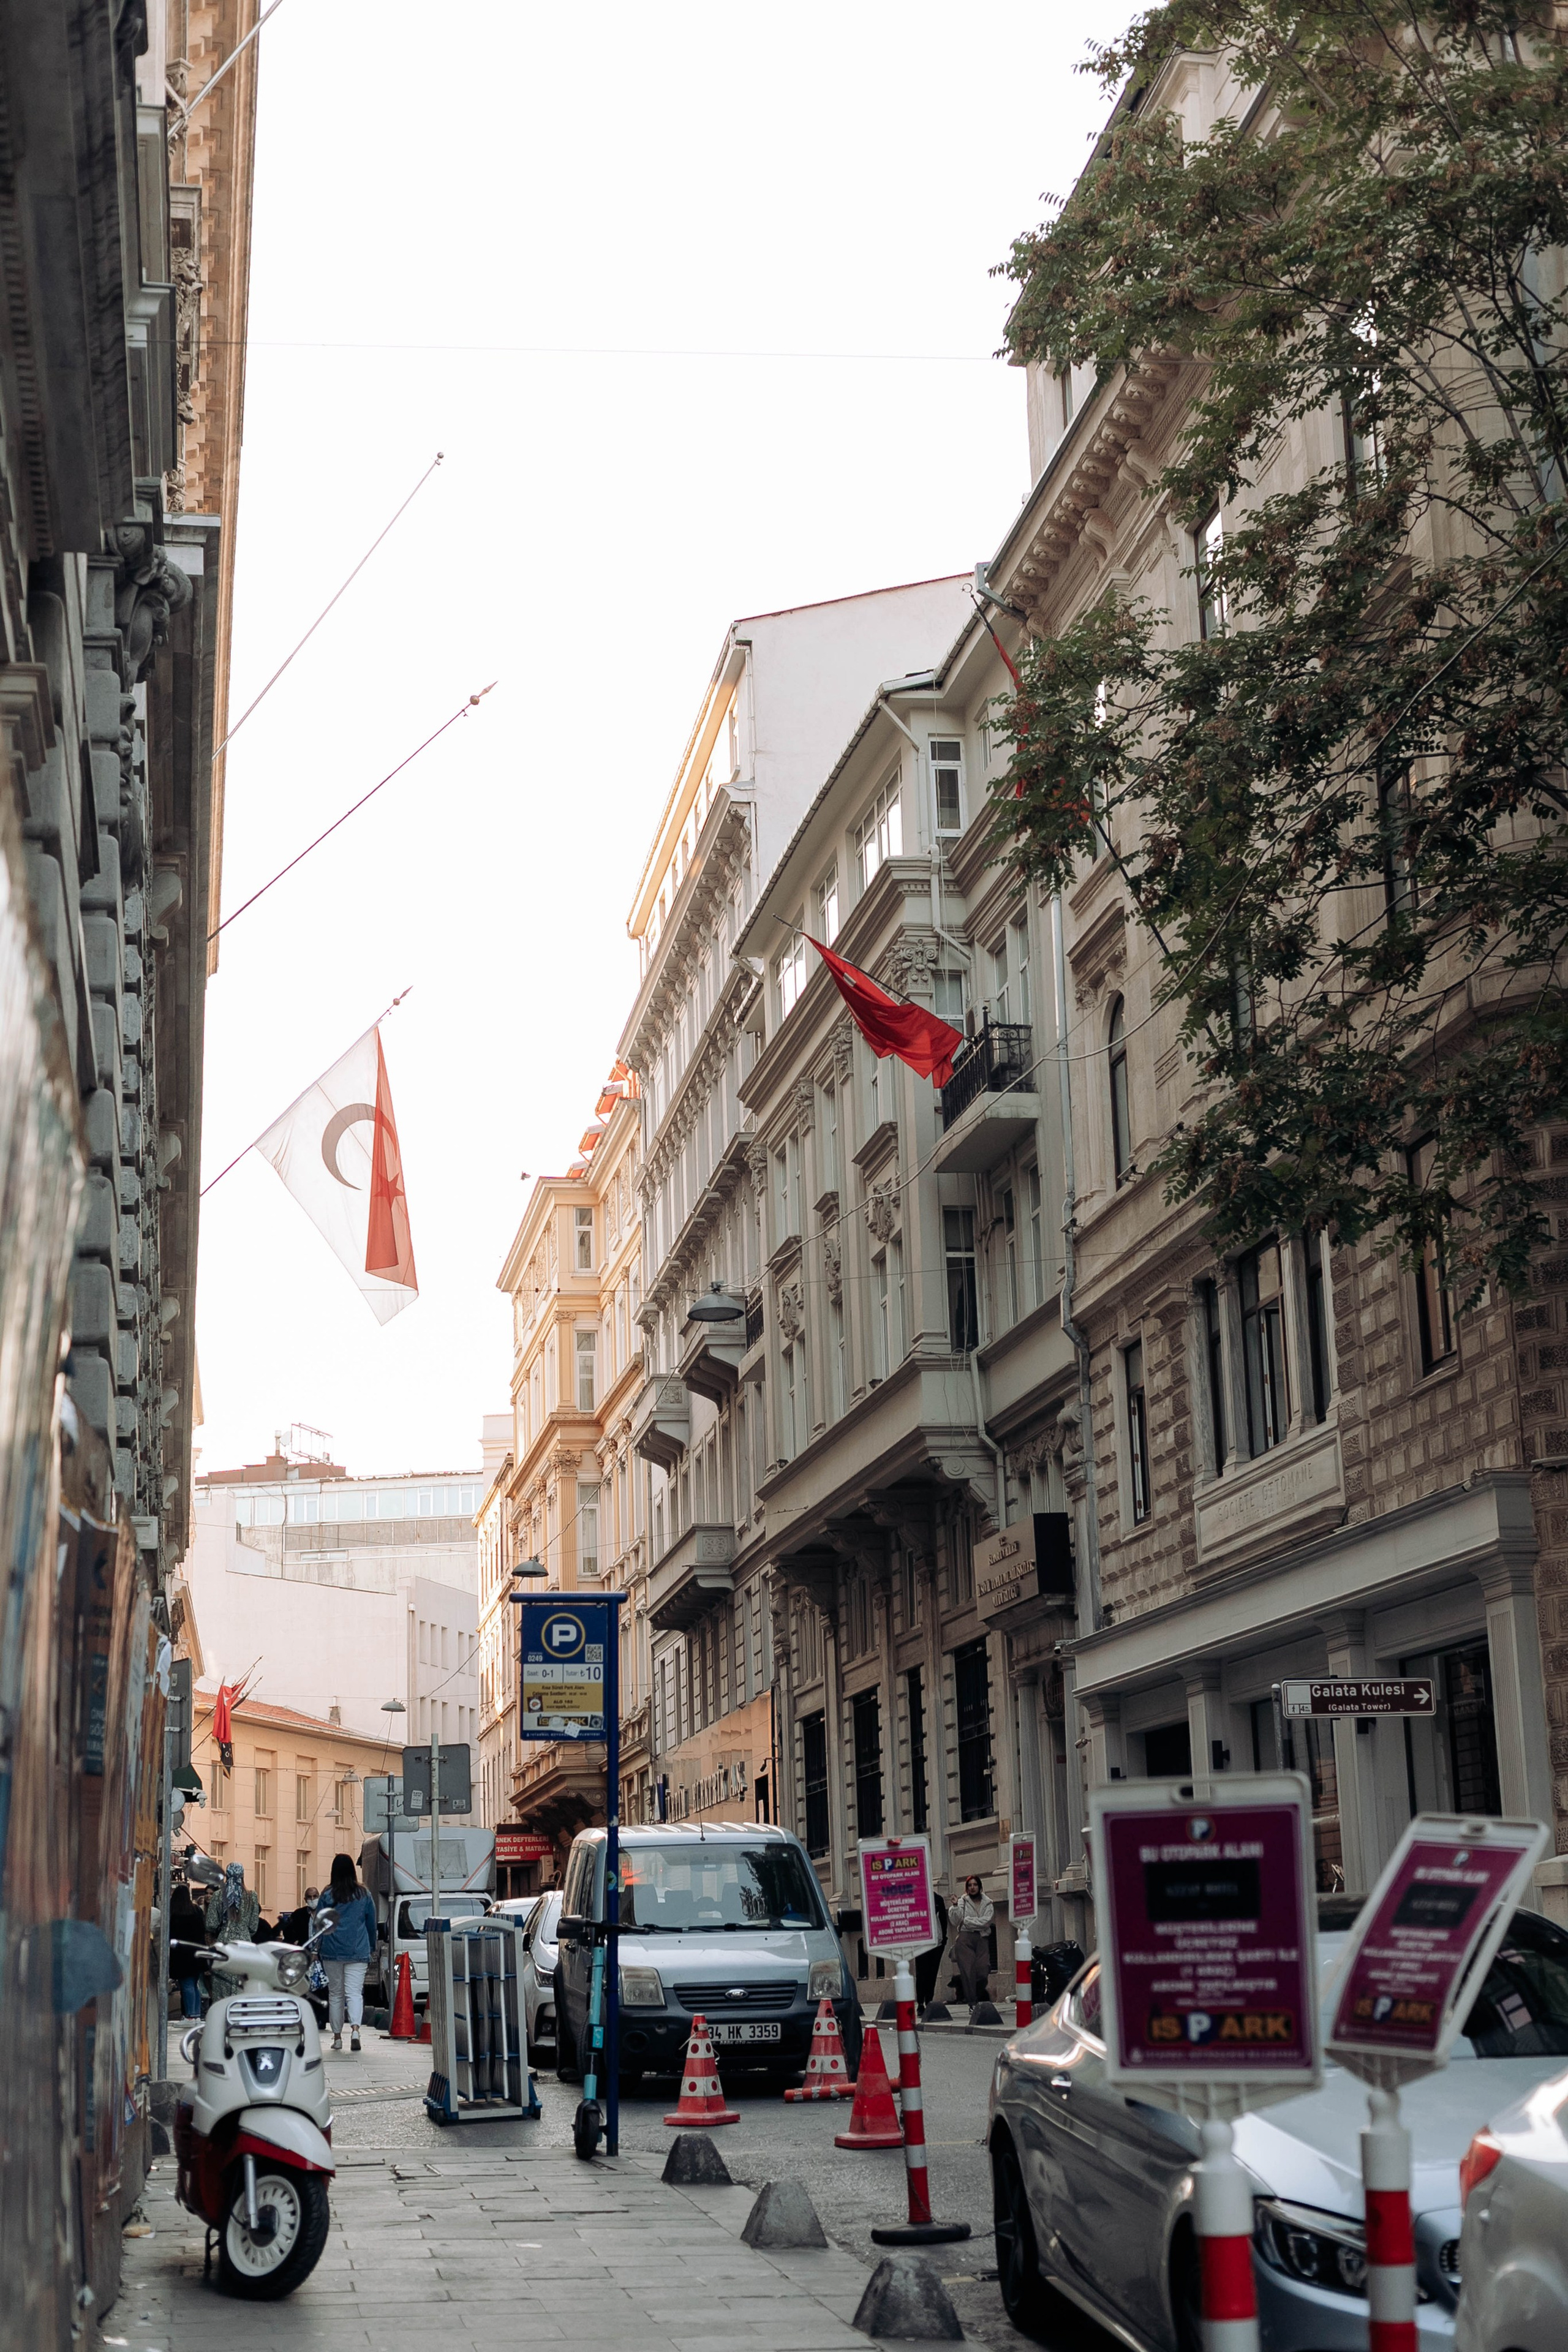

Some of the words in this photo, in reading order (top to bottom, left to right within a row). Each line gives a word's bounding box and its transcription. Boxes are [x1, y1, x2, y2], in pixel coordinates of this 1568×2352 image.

[1218, 1491, 1254, 1522] SOCIETE
[1262, 1463, 1313, 1501] OTTOMANE
[552, 1624, 576, 1646] P
[542, 1669, 553, 1678] 0-1
[1312, 1684, 1357, 1697] Galata
[1362, 1683, 1405, 1695] Kulesi
[708, 2026, 722, 2040] 34
[728, 2026, 742, 2039] HK
[749, 2024, 778, 2038] 3359
